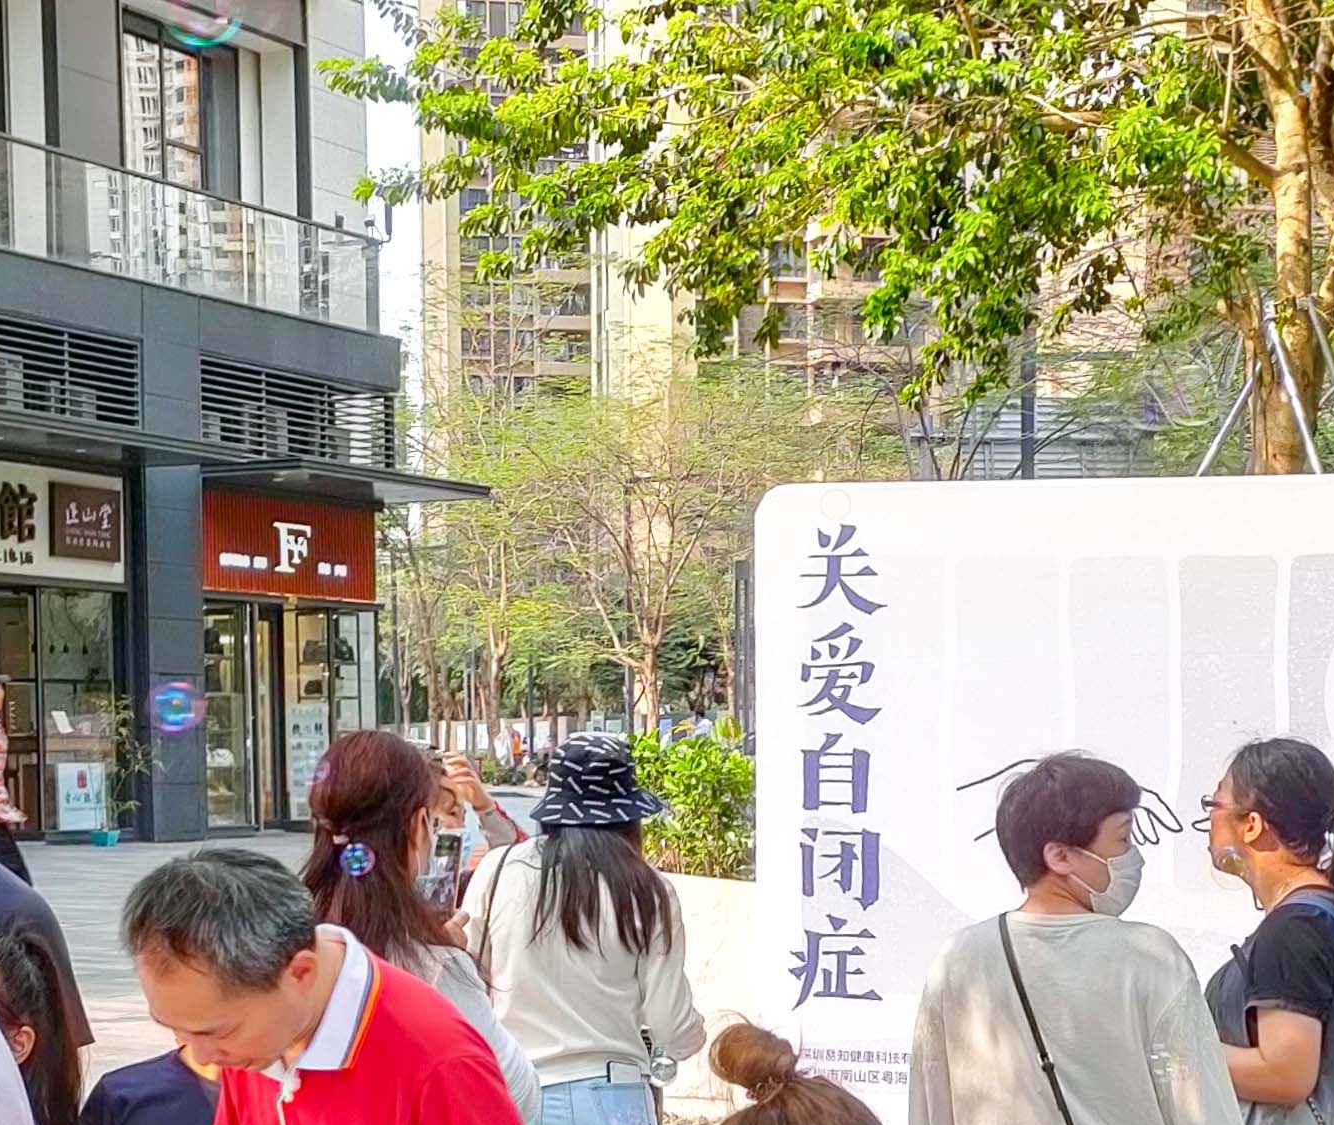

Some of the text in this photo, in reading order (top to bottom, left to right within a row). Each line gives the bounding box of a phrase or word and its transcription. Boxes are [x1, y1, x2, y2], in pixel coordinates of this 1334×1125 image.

[788, 523, 888, 1011] 关爱自闭症
